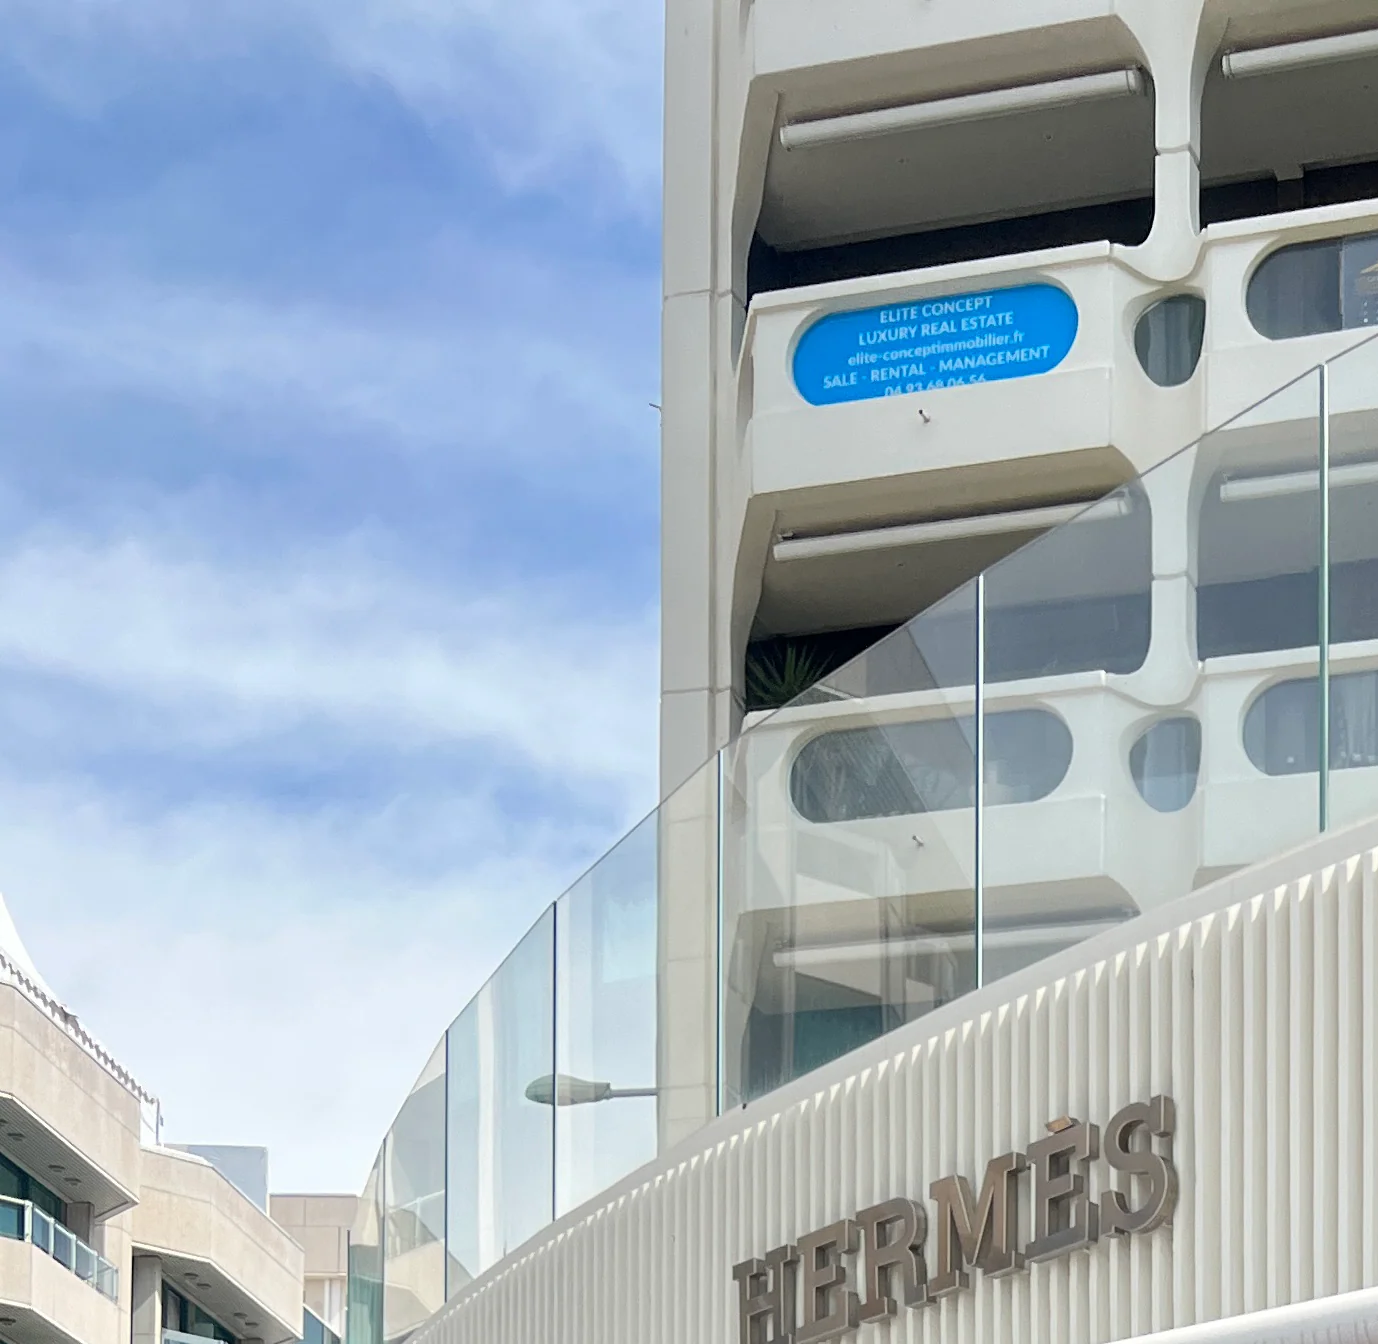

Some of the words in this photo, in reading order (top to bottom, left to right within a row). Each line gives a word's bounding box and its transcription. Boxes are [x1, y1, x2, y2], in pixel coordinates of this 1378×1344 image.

[879, 307, 918, 324] ELITE
[921, 296, 993, 317] CONCEPT
[858, 324, 916, 346] LUXURY
[921, 320, 957, 337] REAL
[961, 311, 1014, 331] ESTATE
[847, 329, 1025, 366] elite-conceptimmobilier.fr
[823, 370, 858, 389] SALE
[870, 363, 926, 382] RENTAL
[938, 345, 1051, 372] MANAGEMENT
